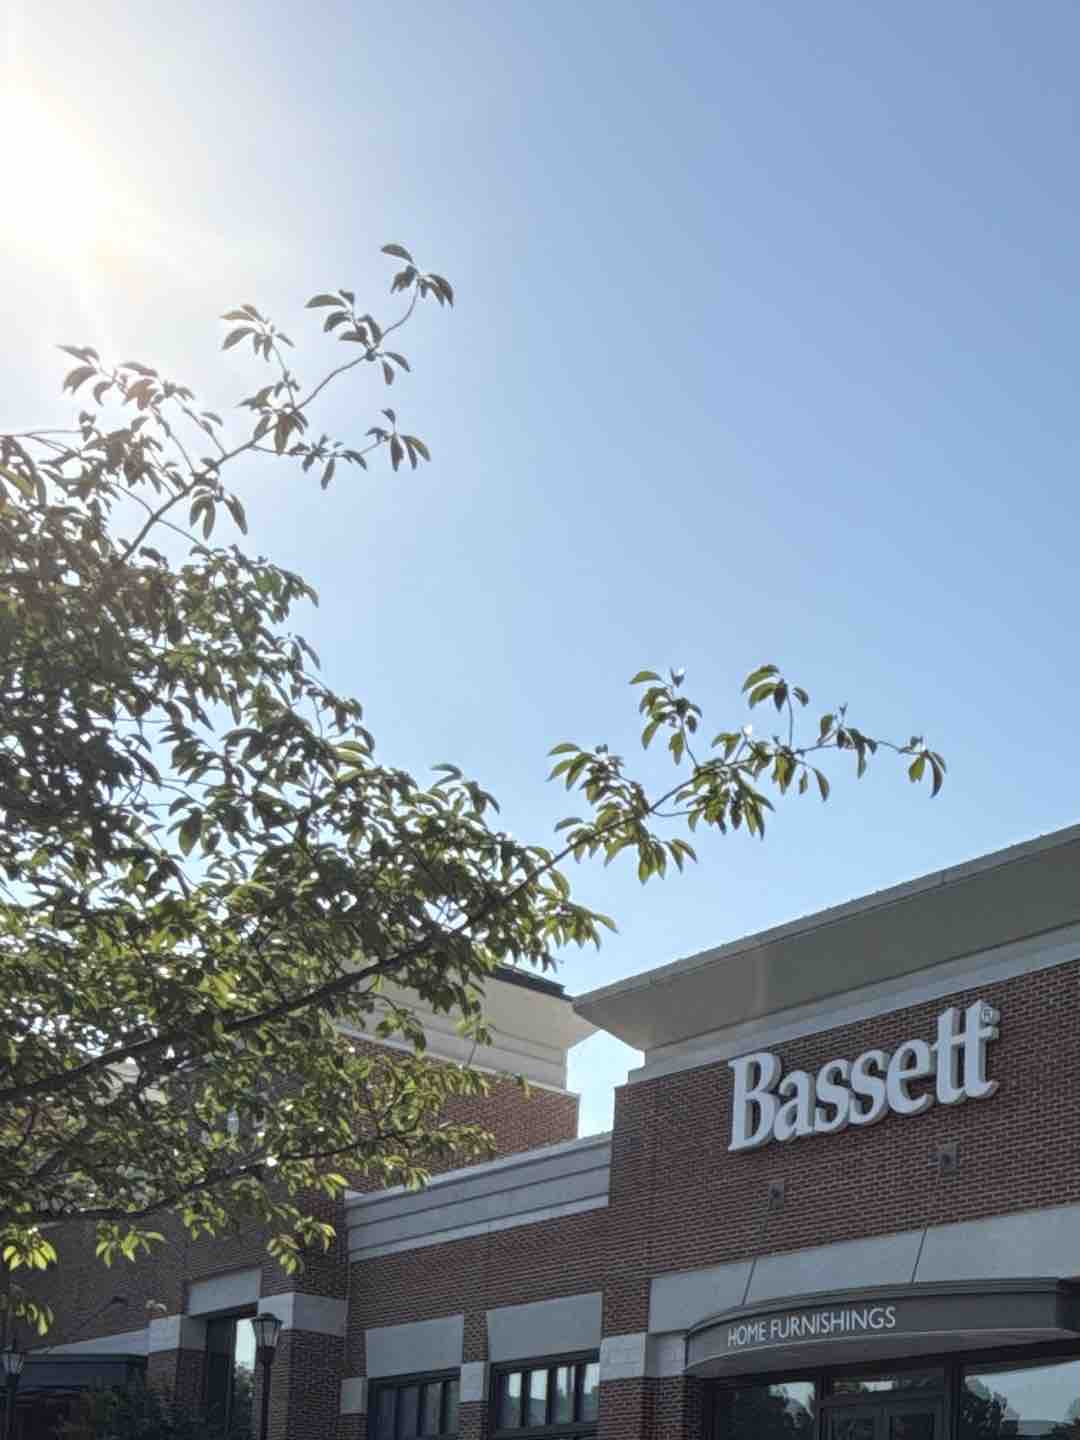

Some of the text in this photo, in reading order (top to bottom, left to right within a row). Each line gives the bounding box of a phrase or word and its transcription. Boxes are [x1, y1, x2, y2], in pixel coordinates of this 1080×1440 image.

[727, 999, 999, 1151] Bassett
[727, 1306, 897, 1348] HOME FURNISHINGS
